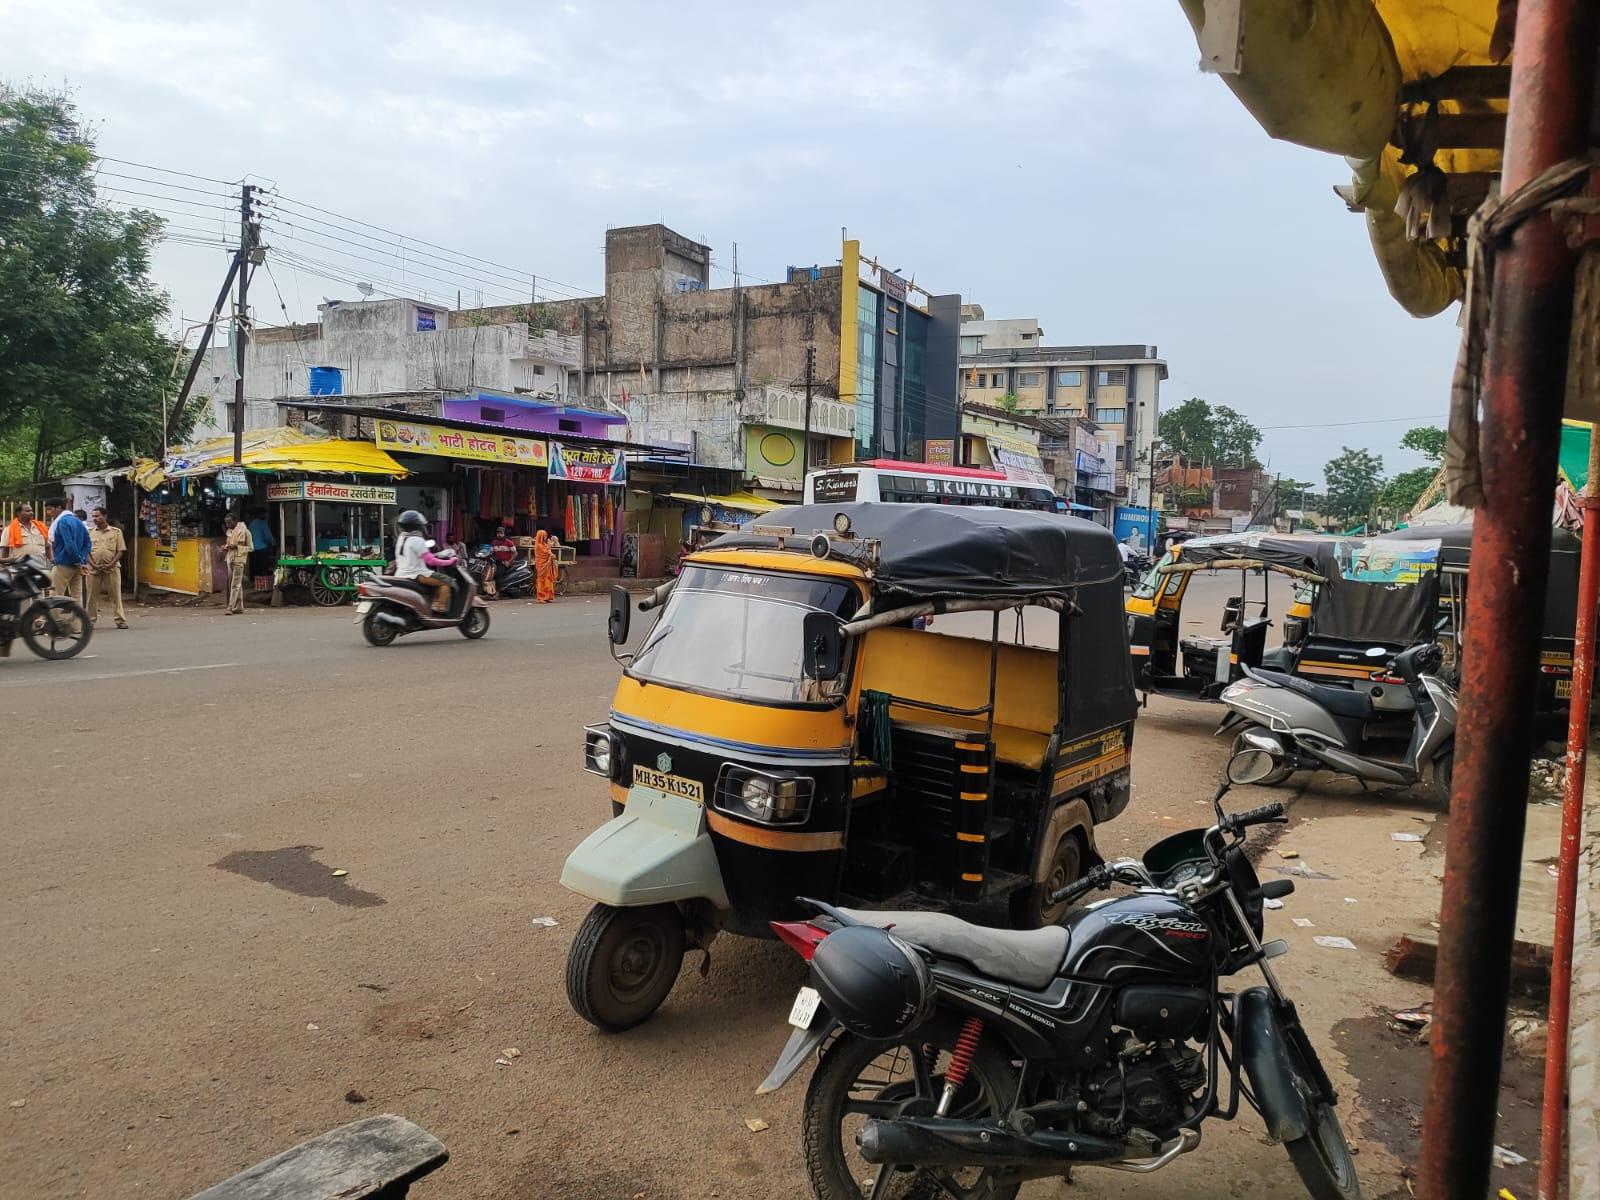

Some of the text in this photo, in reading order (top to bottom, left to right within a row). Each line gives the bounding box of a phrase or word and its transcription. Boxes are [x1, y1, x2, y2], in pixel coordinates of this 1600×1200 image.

[467, 435, 497, 453] होटल
[1009, 1002, 1056, 1029] HERO HONDA
